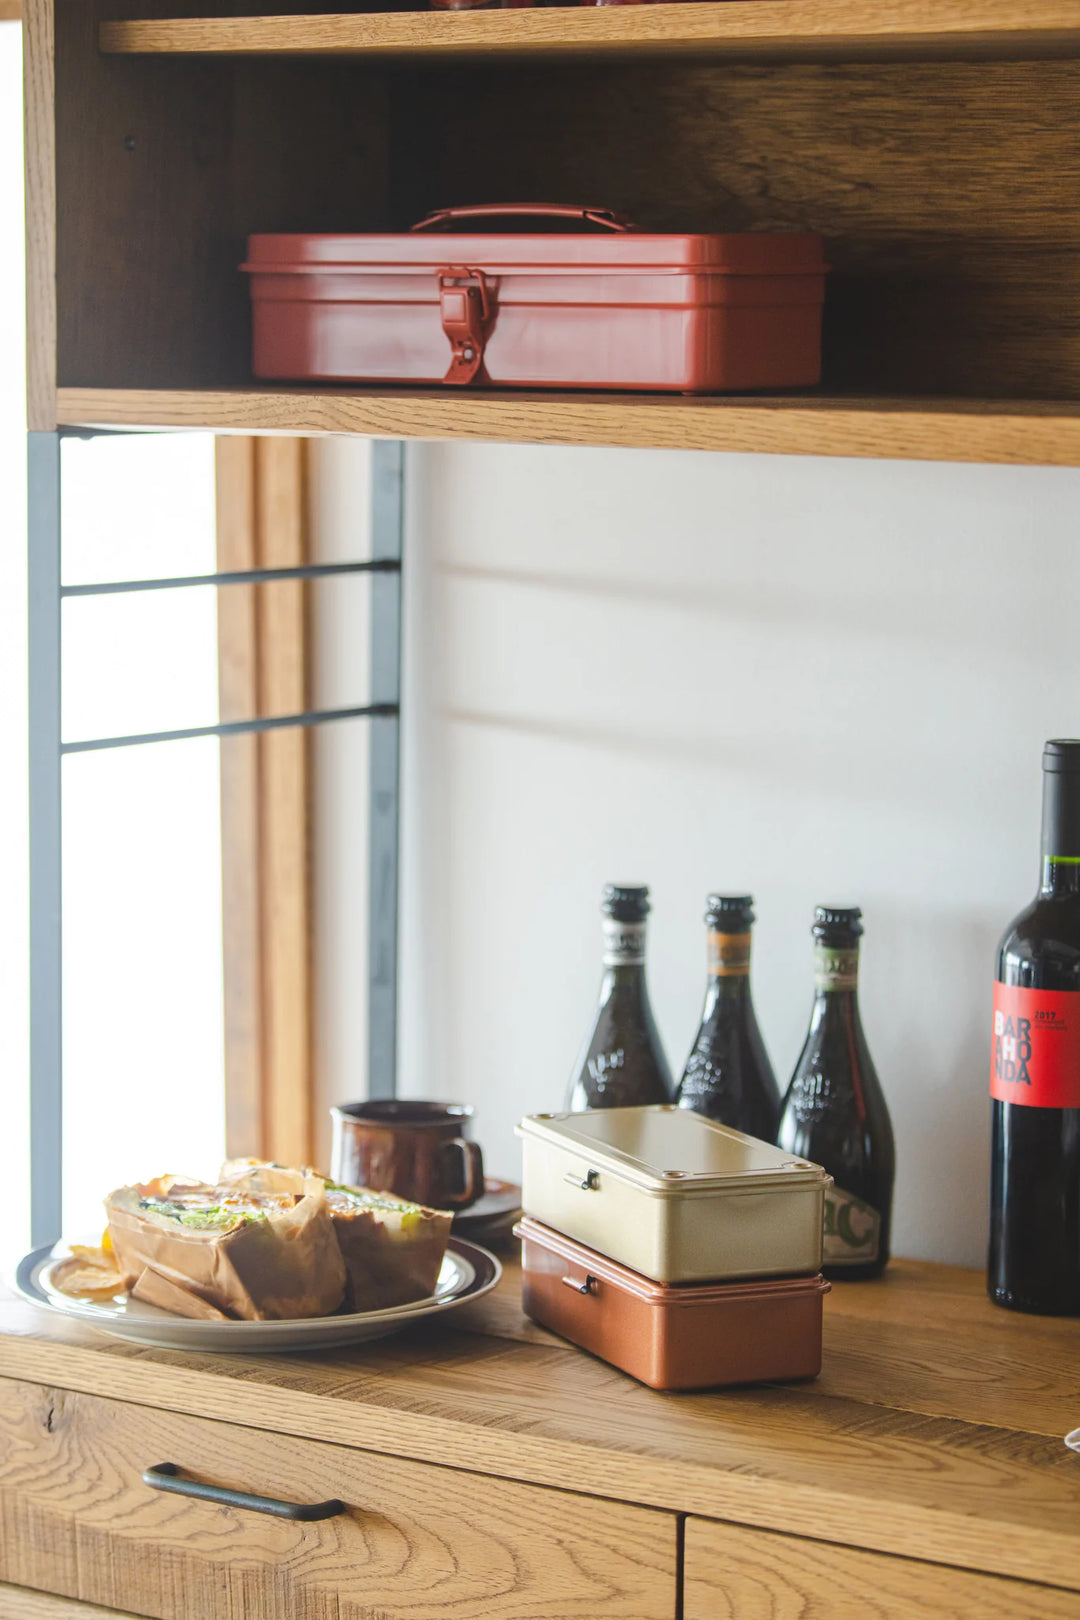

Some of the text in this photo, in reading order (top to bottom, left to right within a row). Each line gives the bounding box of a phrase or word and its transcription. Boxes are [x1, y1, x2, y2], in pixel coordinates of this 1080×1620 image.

[995, 1011, 1031, 1041] BAR
[995, 1035, 1032, 1062] AHO
[995, 1059, 1032, 1085] NDA
